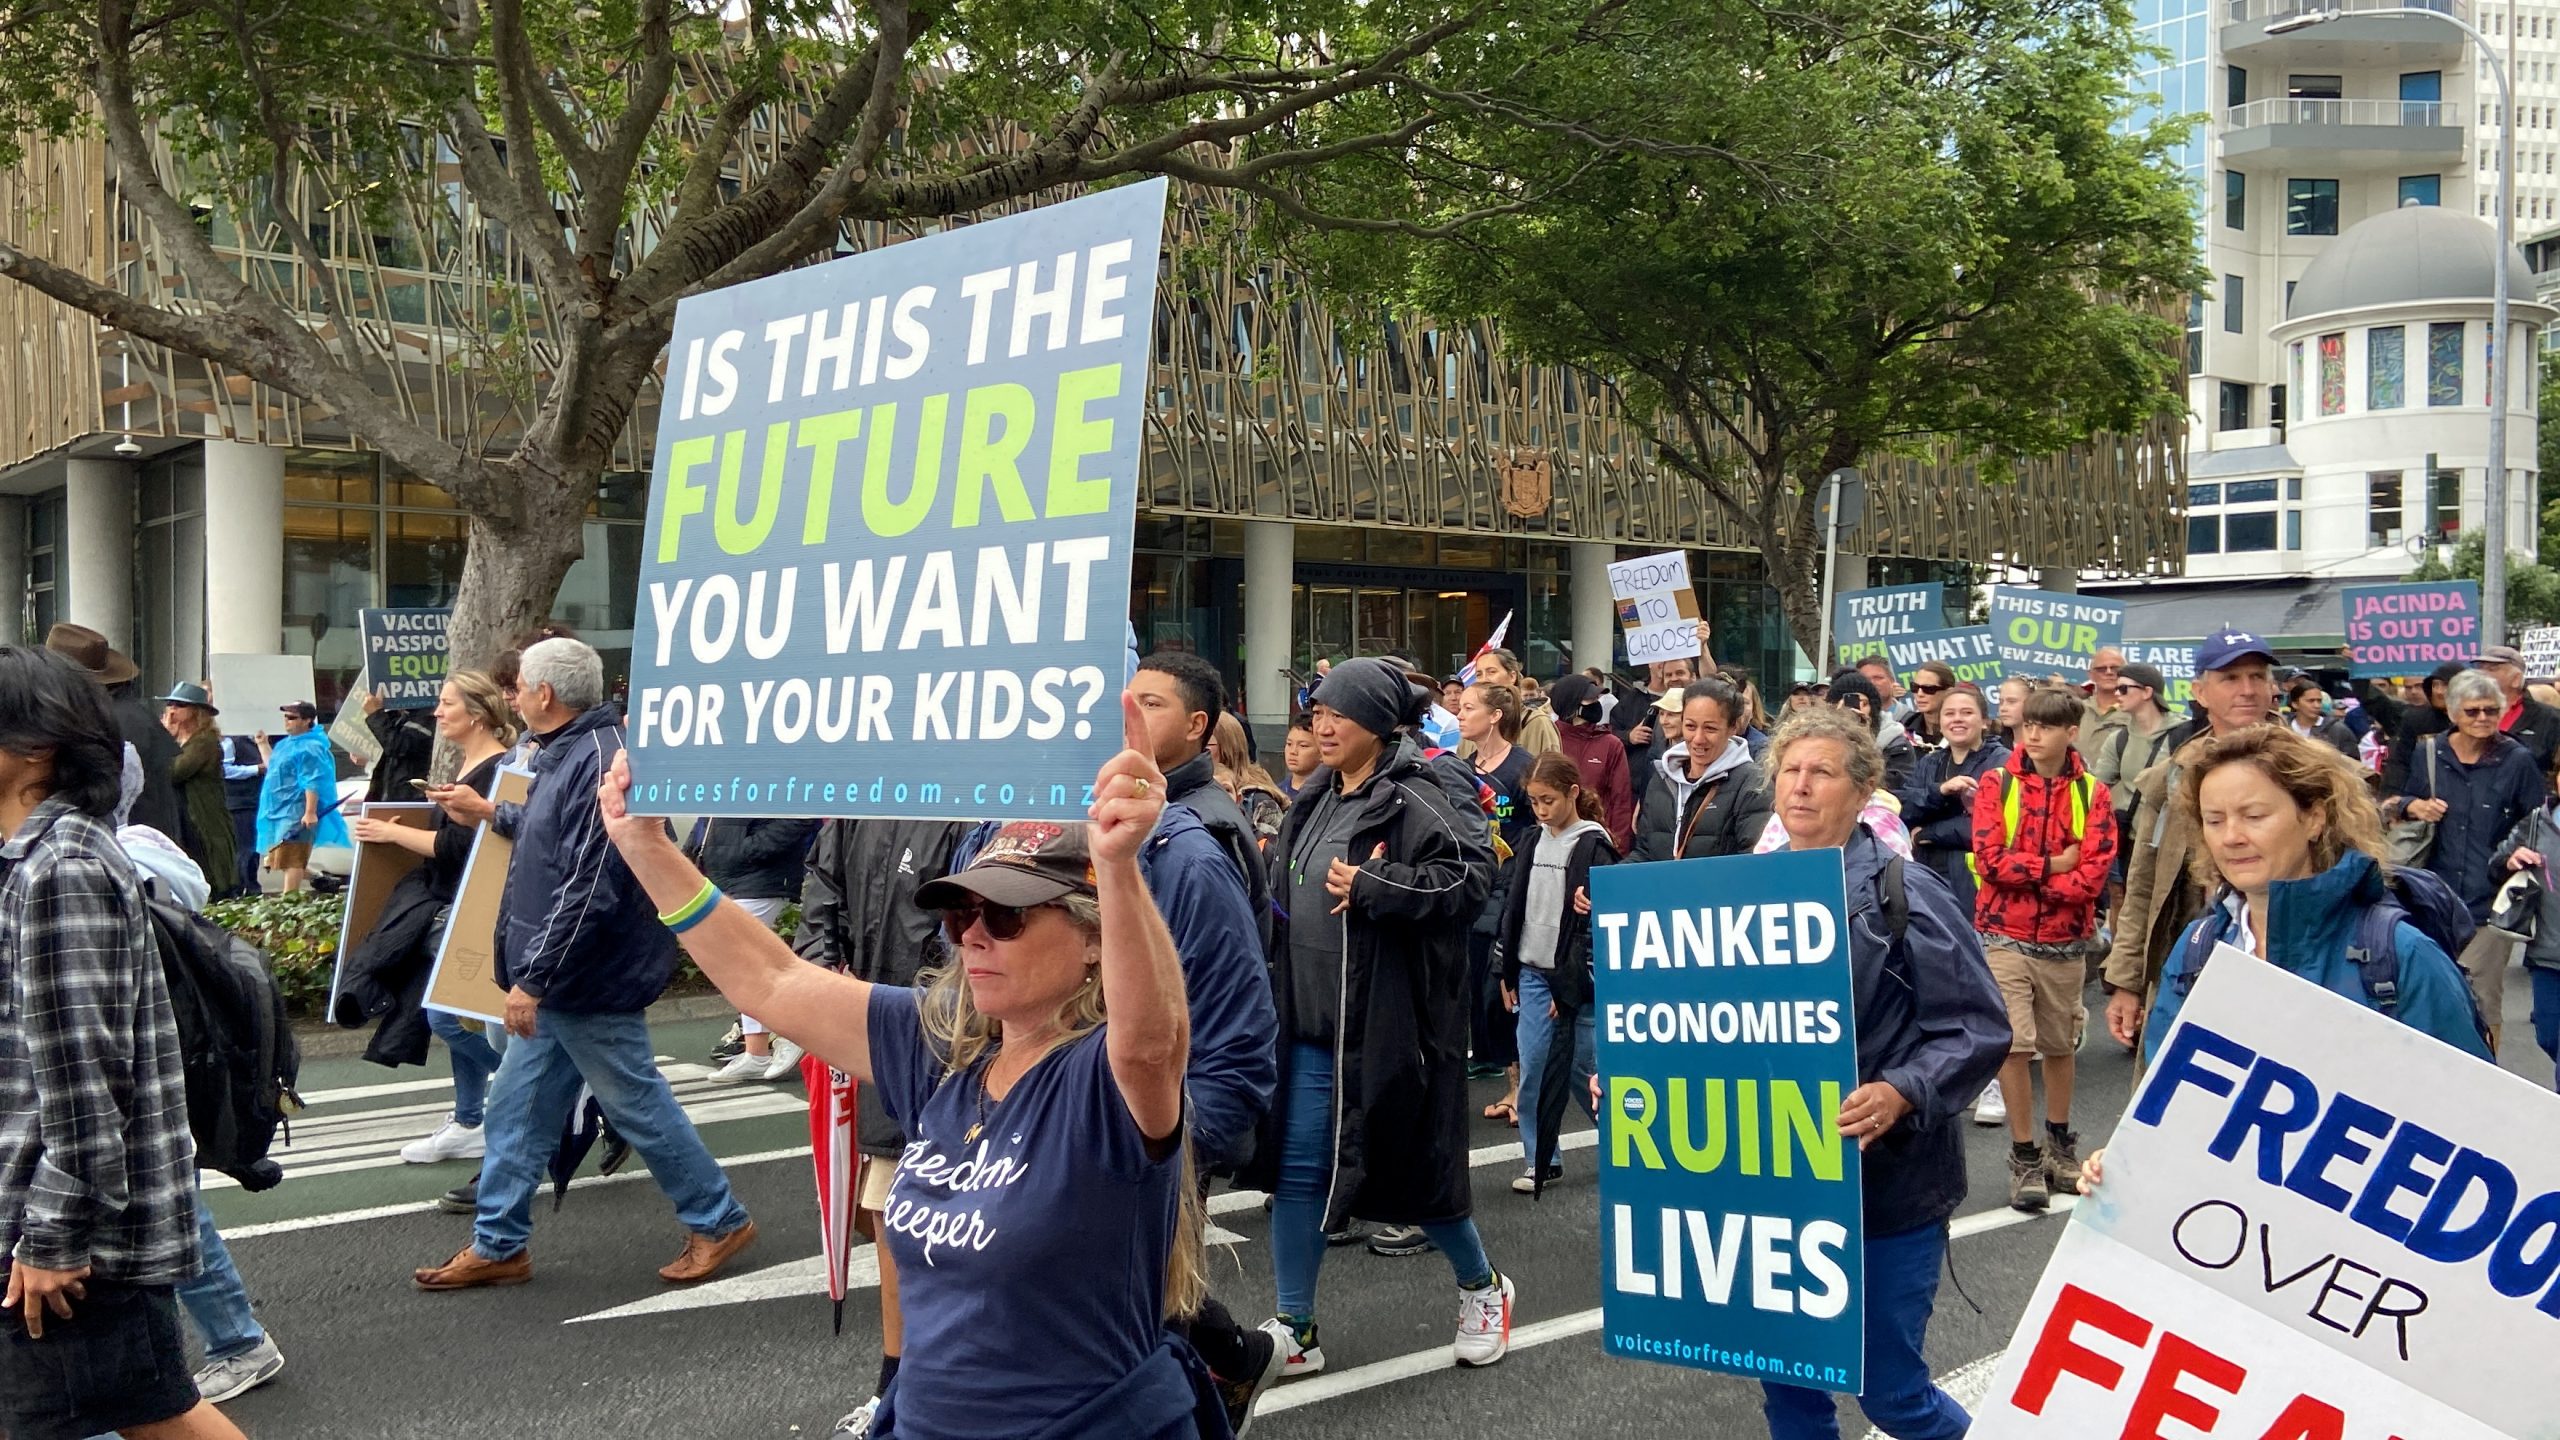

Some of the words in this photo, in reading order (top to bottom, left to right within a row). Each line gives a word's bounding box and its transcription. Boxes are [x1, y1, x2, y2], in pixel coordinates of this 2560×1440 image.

[679, 330, 745, 421] IS
[764, 285, 937, 403] THIS
[961, 238, 1133, 366] THE
[657, 362, 1122, 563] FUTURE
[1610, 561, 1685, 598] FREEDOM
[649, 566, 798, 667] YOU
[823, 535, 1111, 654] WANT
[1640, 599, 1668, 622] TO
[1848, 591, 1927, 617] TRUTH
[1996, 595, 2043, 614] THIS
[2049, 602, 2069, 618] IS
[2074, 606, 2122, 625] NOT
[2353, 592, 2466, 620] JACINDA
[1628, 625, 1698, 657] CHOOSE
[1855, 614, 1915, 638] WILL
[2008, 616, 2099, 654] OUR
[2349, 622, 2373, 641] IS
[2379, 619, 2434, 640] OUT
[2440, 617, 2475, 637] OF
[1889, 636, 1967, 666] WHAT
[1971, 634, 1994, 655] IF
[2147, 647, 2194, 664] ARE
[2352, 642, 2478, 663] CONTROL!
[637, 684, 724, 748] FOR
[740, 674, 893, 745] YOUR
[912, 665, 1106, 741] KIDS?
[633, 776, 1095, 808] voicesforfreedom.co.nz
[1598, 901, 1836, 970] TANKED
[1606, 1001, 1841, 1044] ECONOMIES
[1610, 1076, 1843, 1182] RUIN
[2133, 1022, 2560, 1320] FREEDO
[1614, 1203, 1849, 1319] LIVES
[2173, 1200, 2429, 1361] OVER
[1614, 1333, 1848, 1385] voicesforfreedom.co.nz
